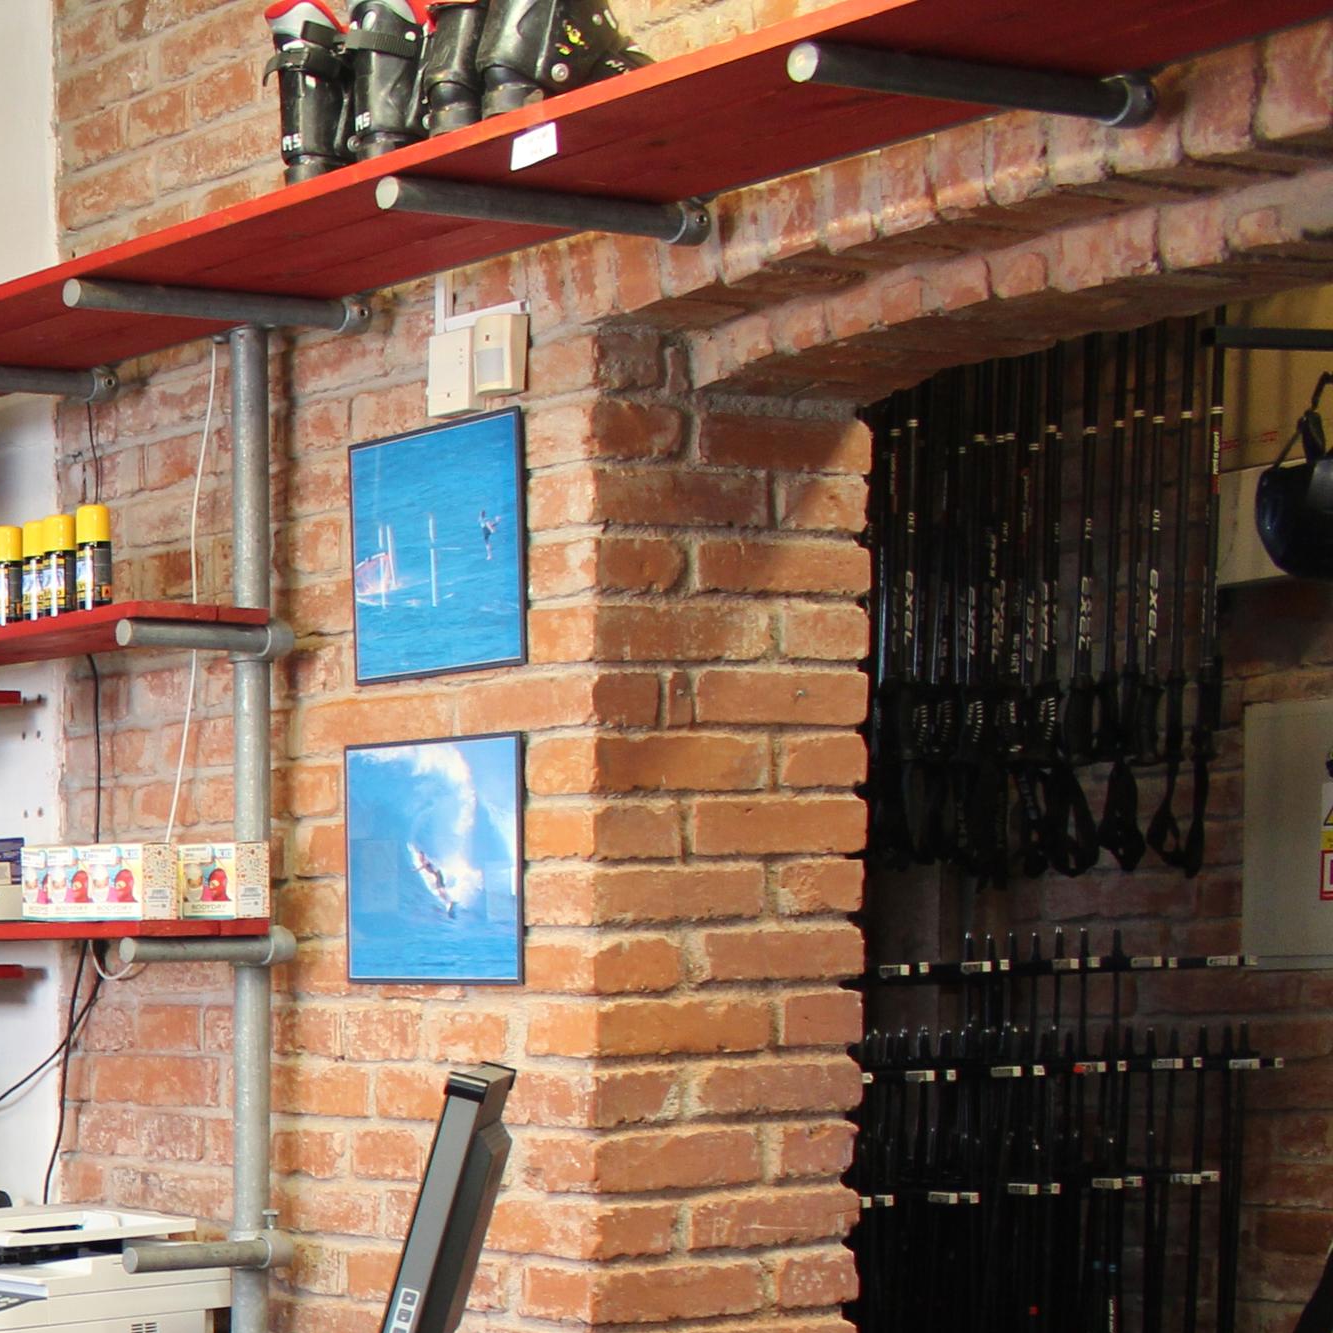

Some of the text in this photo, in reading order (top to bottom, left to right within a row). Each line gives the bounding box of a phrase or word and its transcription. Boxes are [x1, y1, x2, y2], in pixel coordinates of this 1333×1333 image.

[906, 511, 916, 534] 130
[1083, 517, 1094, 540] 130
[1151, 508, 1161, 532] 130
[903, 568, 916, 647] EXEL
[1148, 567, 1159, 645] EXEL
